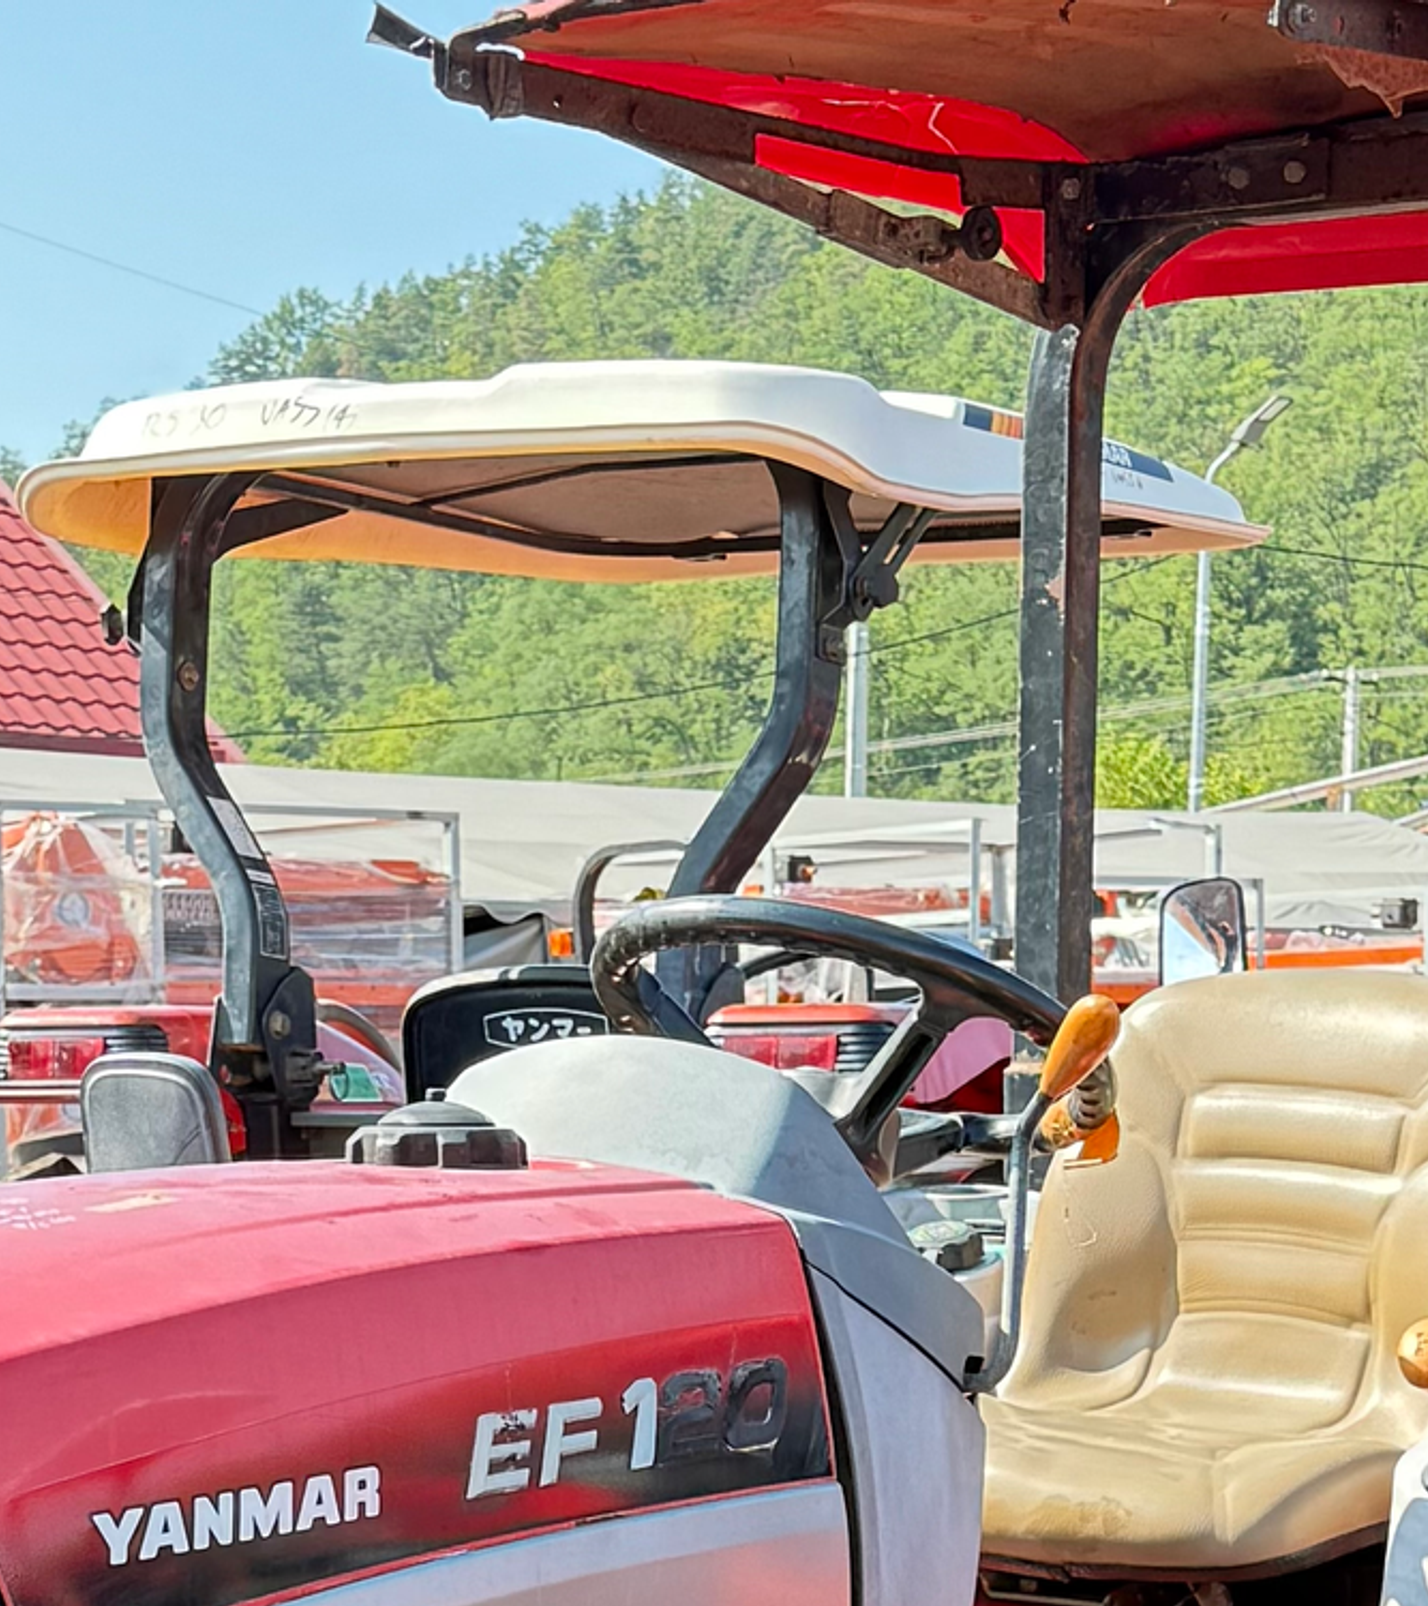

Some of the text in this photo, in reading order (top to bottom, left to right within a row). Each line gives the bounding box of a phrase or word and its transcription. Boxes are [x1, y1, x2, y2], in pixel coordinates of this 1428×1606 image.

[501, 1016, 592, 1043] ヤンマー
[92, 1466, 382, 1566] YANMAR
